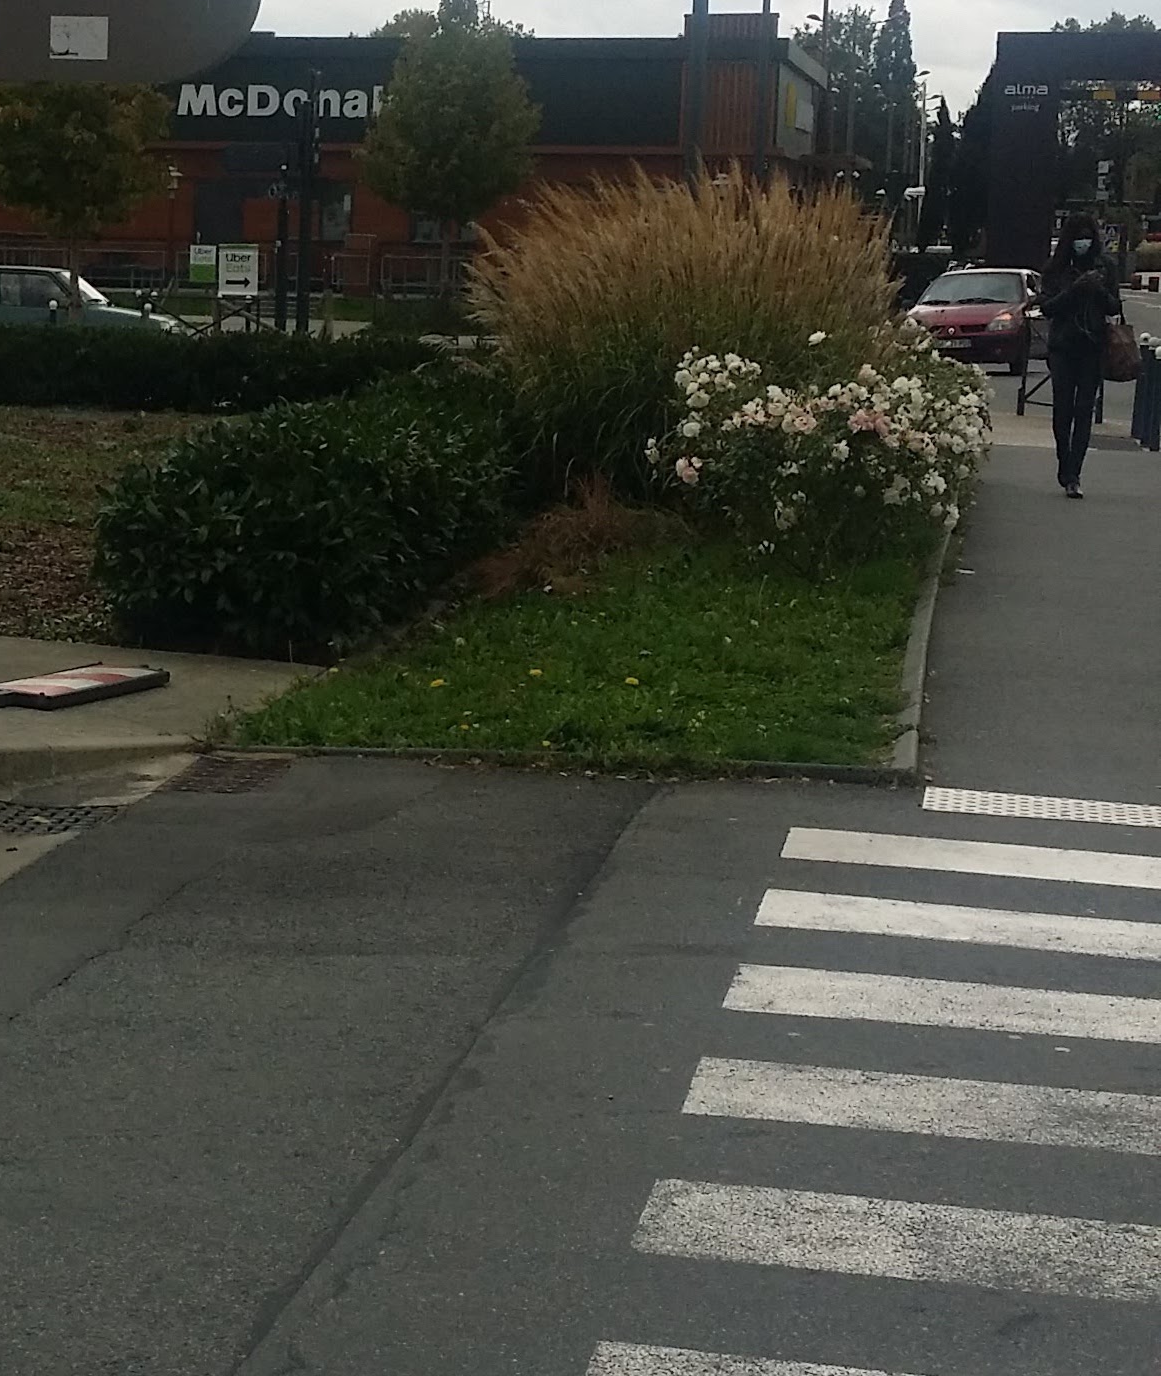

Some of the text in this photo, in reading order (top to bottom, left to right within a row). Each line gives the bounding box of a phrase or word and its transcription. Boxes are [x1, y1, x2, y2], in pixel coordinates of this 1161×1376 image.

[1004, 83, 1049, 95] alma
[177, 84, 387, 118] McDonal
[225, 253, 251, 263] Uber
